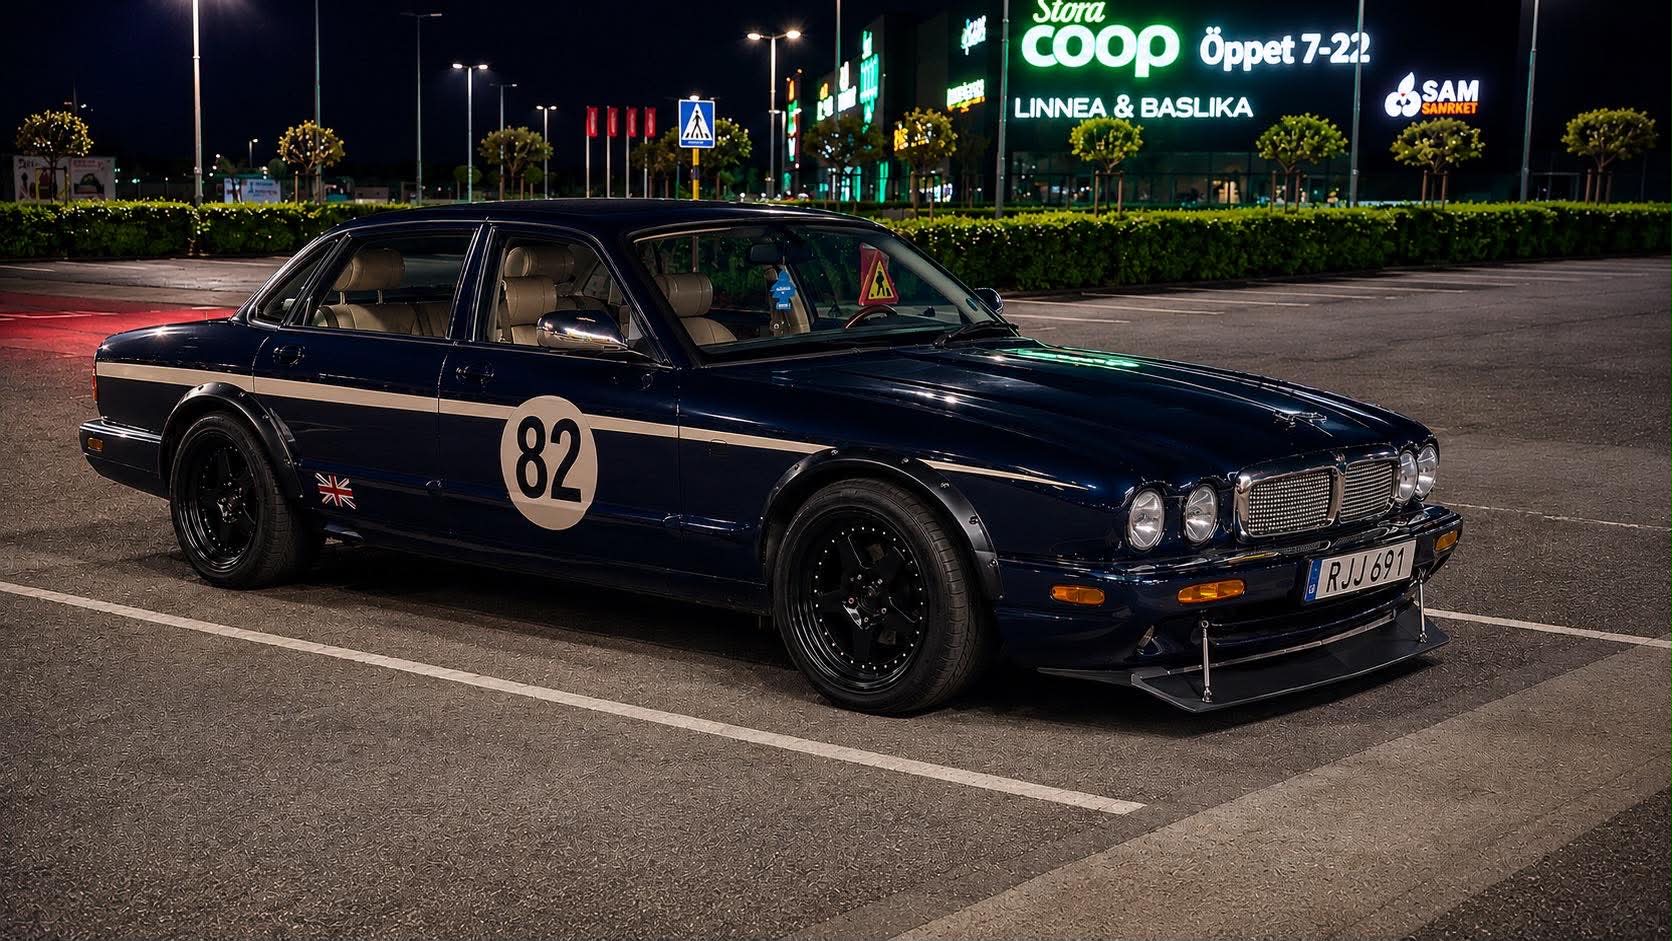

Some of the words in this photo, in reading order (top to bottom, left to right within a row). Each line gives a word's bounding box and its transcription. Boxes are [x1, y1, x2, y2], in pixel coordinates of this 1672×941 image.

[1033, 0, 1105, 23] Stora
[1021, 24, 1180, 78] coop
[1200, 26, 1296, 72] Öppet
[1301, 32, 1371, 64] 7-22
[1014, 97, 1107, 119] LINNEA
[1114, 94, 1134, 119] &
[1141, 96, 1254, 119] BASLIKA
[1422, 79, 1479, 103] SAM
[516, 415, 582, 503] 82
[1326, 555, 1368, 593] RJJ
[1370, 547, 1405, 583] 691
